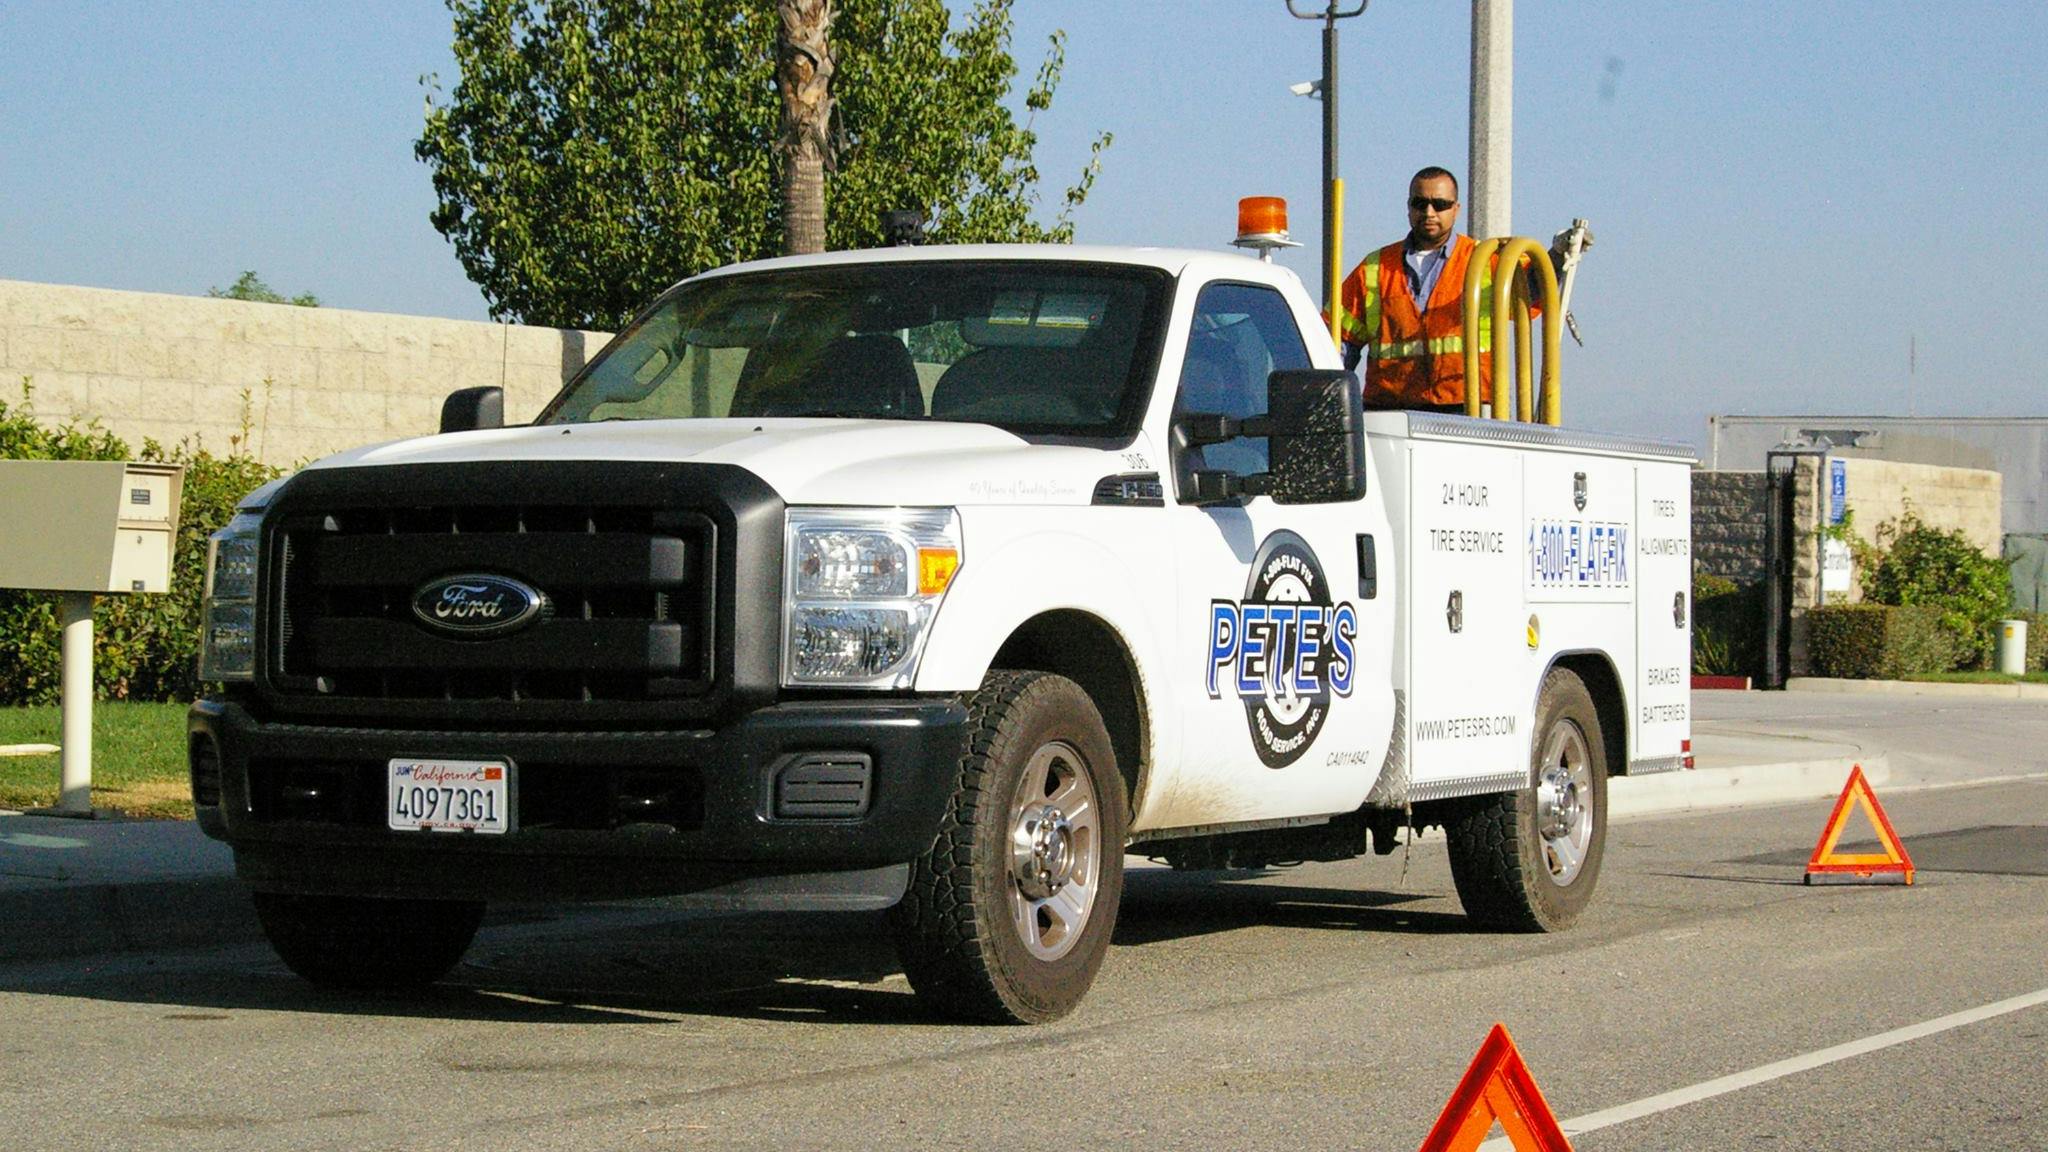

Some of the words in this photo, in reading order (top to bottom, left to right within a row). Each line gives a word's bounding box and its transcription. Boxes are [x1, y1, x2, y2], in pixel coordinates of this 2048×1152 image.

[1443, 483, 1454, 505] 24
[1459, 485, 1489, 507] HOUR
[1653, 499, 1676, 518] TIRES
[1430, 529, 1455, 551] TIRE
[1460, 531, 1503, 554] SERVICE
[1641, 538, 1687, 556] ALIGNMENTS
[435, 584, 504, 618] Ford
[1206, 599, 1357, 699] PETE'S
[1648, 667, 1681, 686] BRAKES
[1642, 703, 1686, 724] BATTERIES
[1256, 707, 1274, 745] ROAD
[1416, 715, 1517, 741] WWW.PETESRS.COM
[414, 764, 480, 785] California
[396, 786, 498, 822] 40973G1
